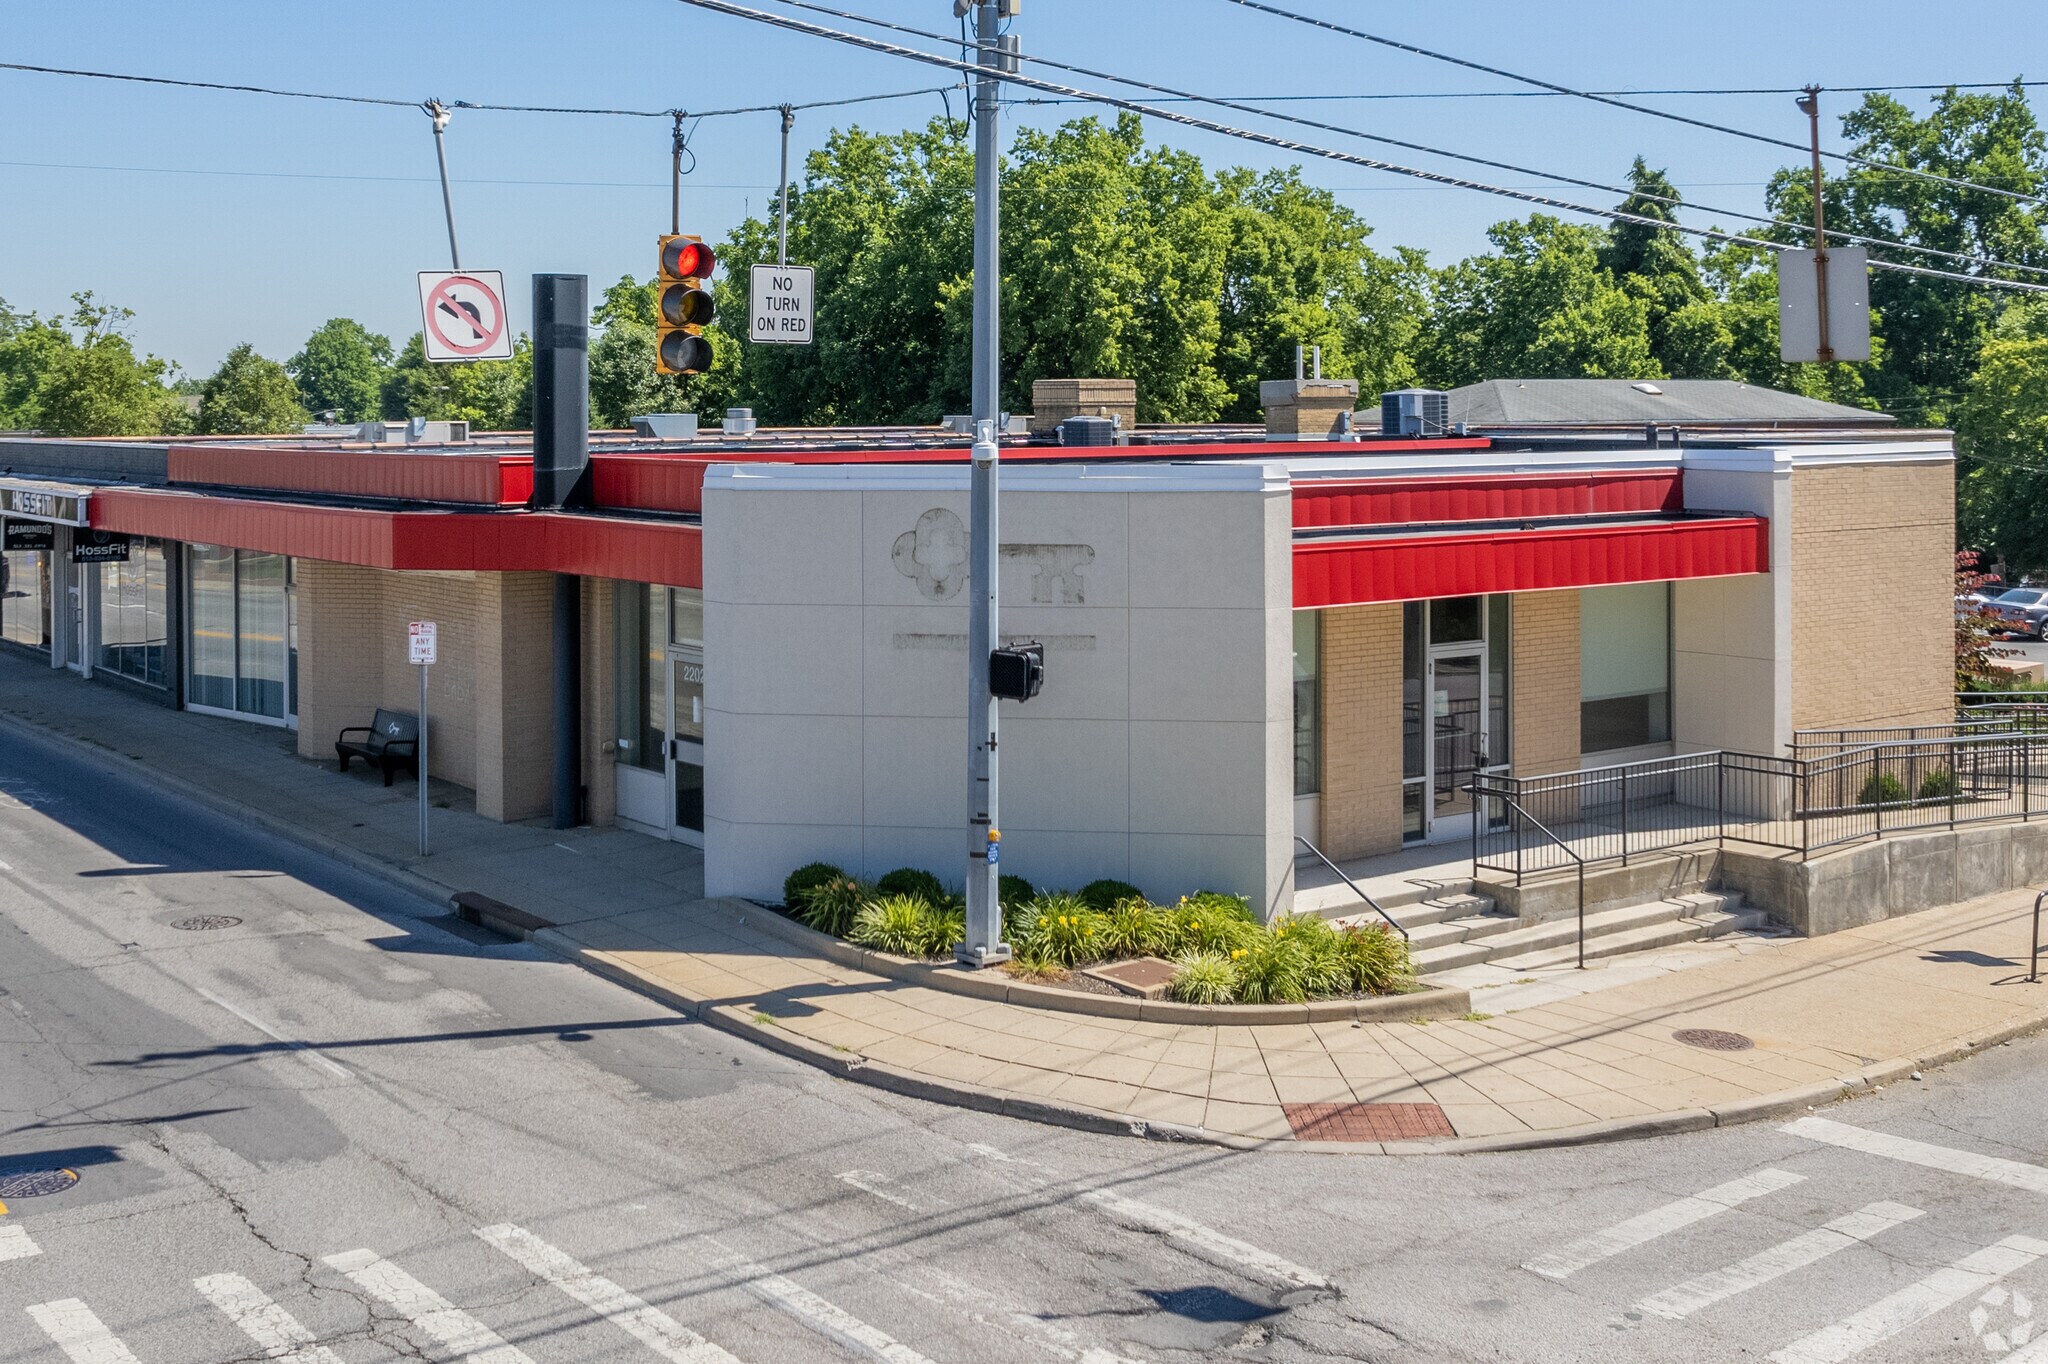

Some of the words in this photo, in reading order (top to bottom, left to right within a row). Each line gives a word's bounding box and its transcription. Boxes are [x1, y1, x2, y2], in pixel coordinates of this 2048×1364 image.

[772, 277, 793, 291] NO
[765, 296, 800, 311] TURN
[757, 317, 775, 331] ON
[781, 317, 806, 332] RED
[12, 490, 52, 516] HOSSFIT
[8, 524, 53, 535] RAMUNDO'S
[75, 543, 127, 556] HossFit
[415, 638, 430, 646] ANY
[414, 647, 431, 656] TIME
